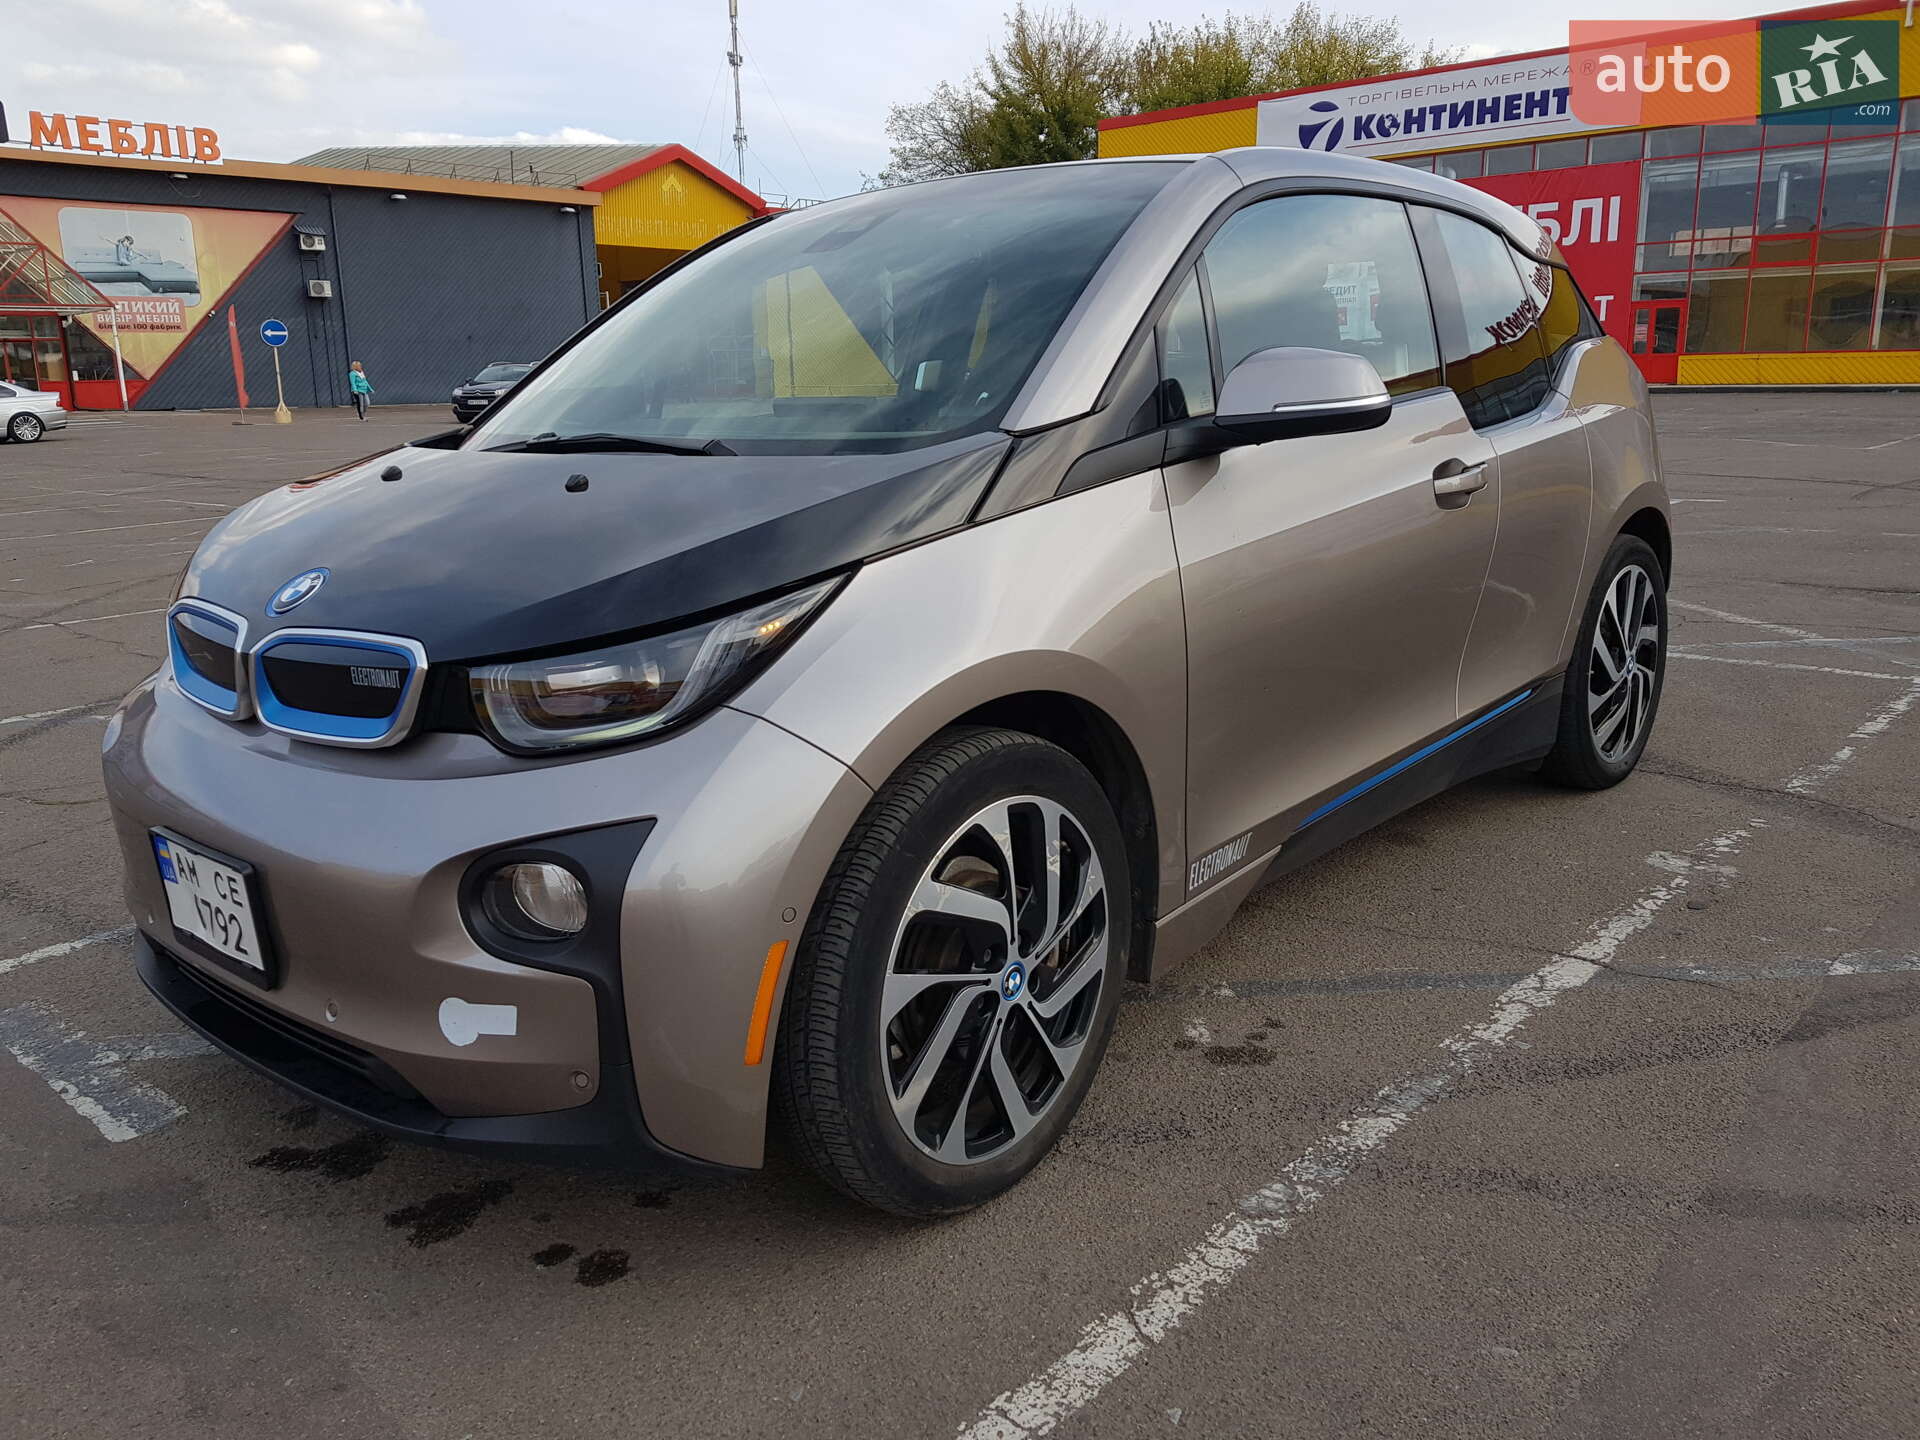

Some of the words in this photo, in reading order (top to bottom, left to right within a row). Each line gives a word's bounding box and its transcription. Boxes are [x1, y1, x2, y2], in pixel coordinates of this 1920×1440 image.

[1347, 79, 1477, 106] ТОРГІВЕЛЬНА
[1483, 64, 1574, 88] МЕРЕЖА
[29, 110, 222, 162] МЕБЛІВ
[1353, 86, 1572, 141] КОНТИНЕНТ
[1511, 195, 1621, 247] БЛІ
[116, 299, 180, 313] ЛИКИЙ
[136, 314, 181, 323] МЕБЛІВ
[149, 323, 182, 331] фабрик
[350, 666, 400, 689] ELECTRONAUT
[175, 852, 200, 888] AM
[214, 871, 244, 908] CE
[1189, 831, 1253, 891] ELECTRONAUT
[193, 893, 249, 956] 1792
